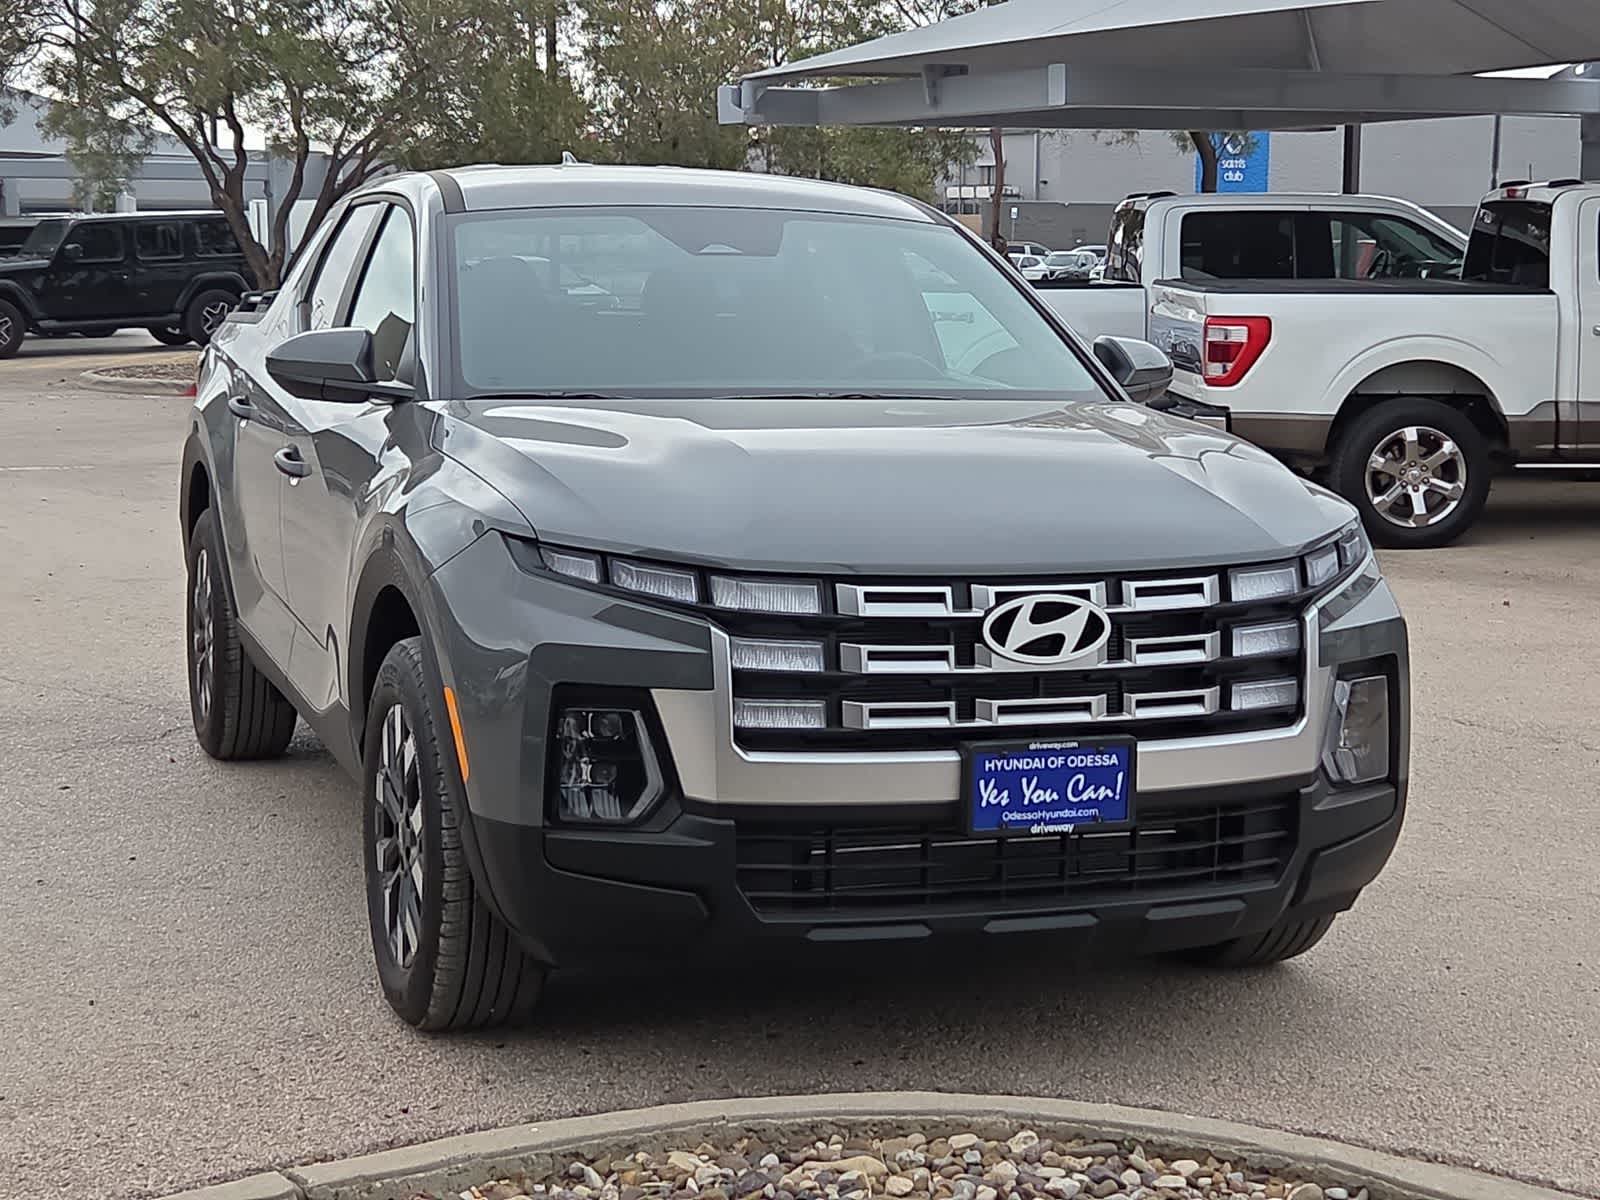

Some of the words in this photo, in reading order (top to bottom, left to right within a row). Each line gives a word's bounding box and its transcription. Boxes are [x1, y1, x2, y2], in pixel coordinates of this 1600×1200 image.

[1223, 170, 1244, 181] club
[1028, 741, 1079, 751] driveway.com
[985, 757, 1045, 772] HYUNDAI
[1047, 756, 1065, 769] OF
[1067, 754, 1119, 768] ODESSA
[979, 778, 1010, 807] Yes
[1021, 775, 1059, 806] You
[1066, 771, 1124, 803] Can!
[1002, 808, 1099, 821] OdessaHyundai.com
[1030, 822, 1075, 834] driveway
